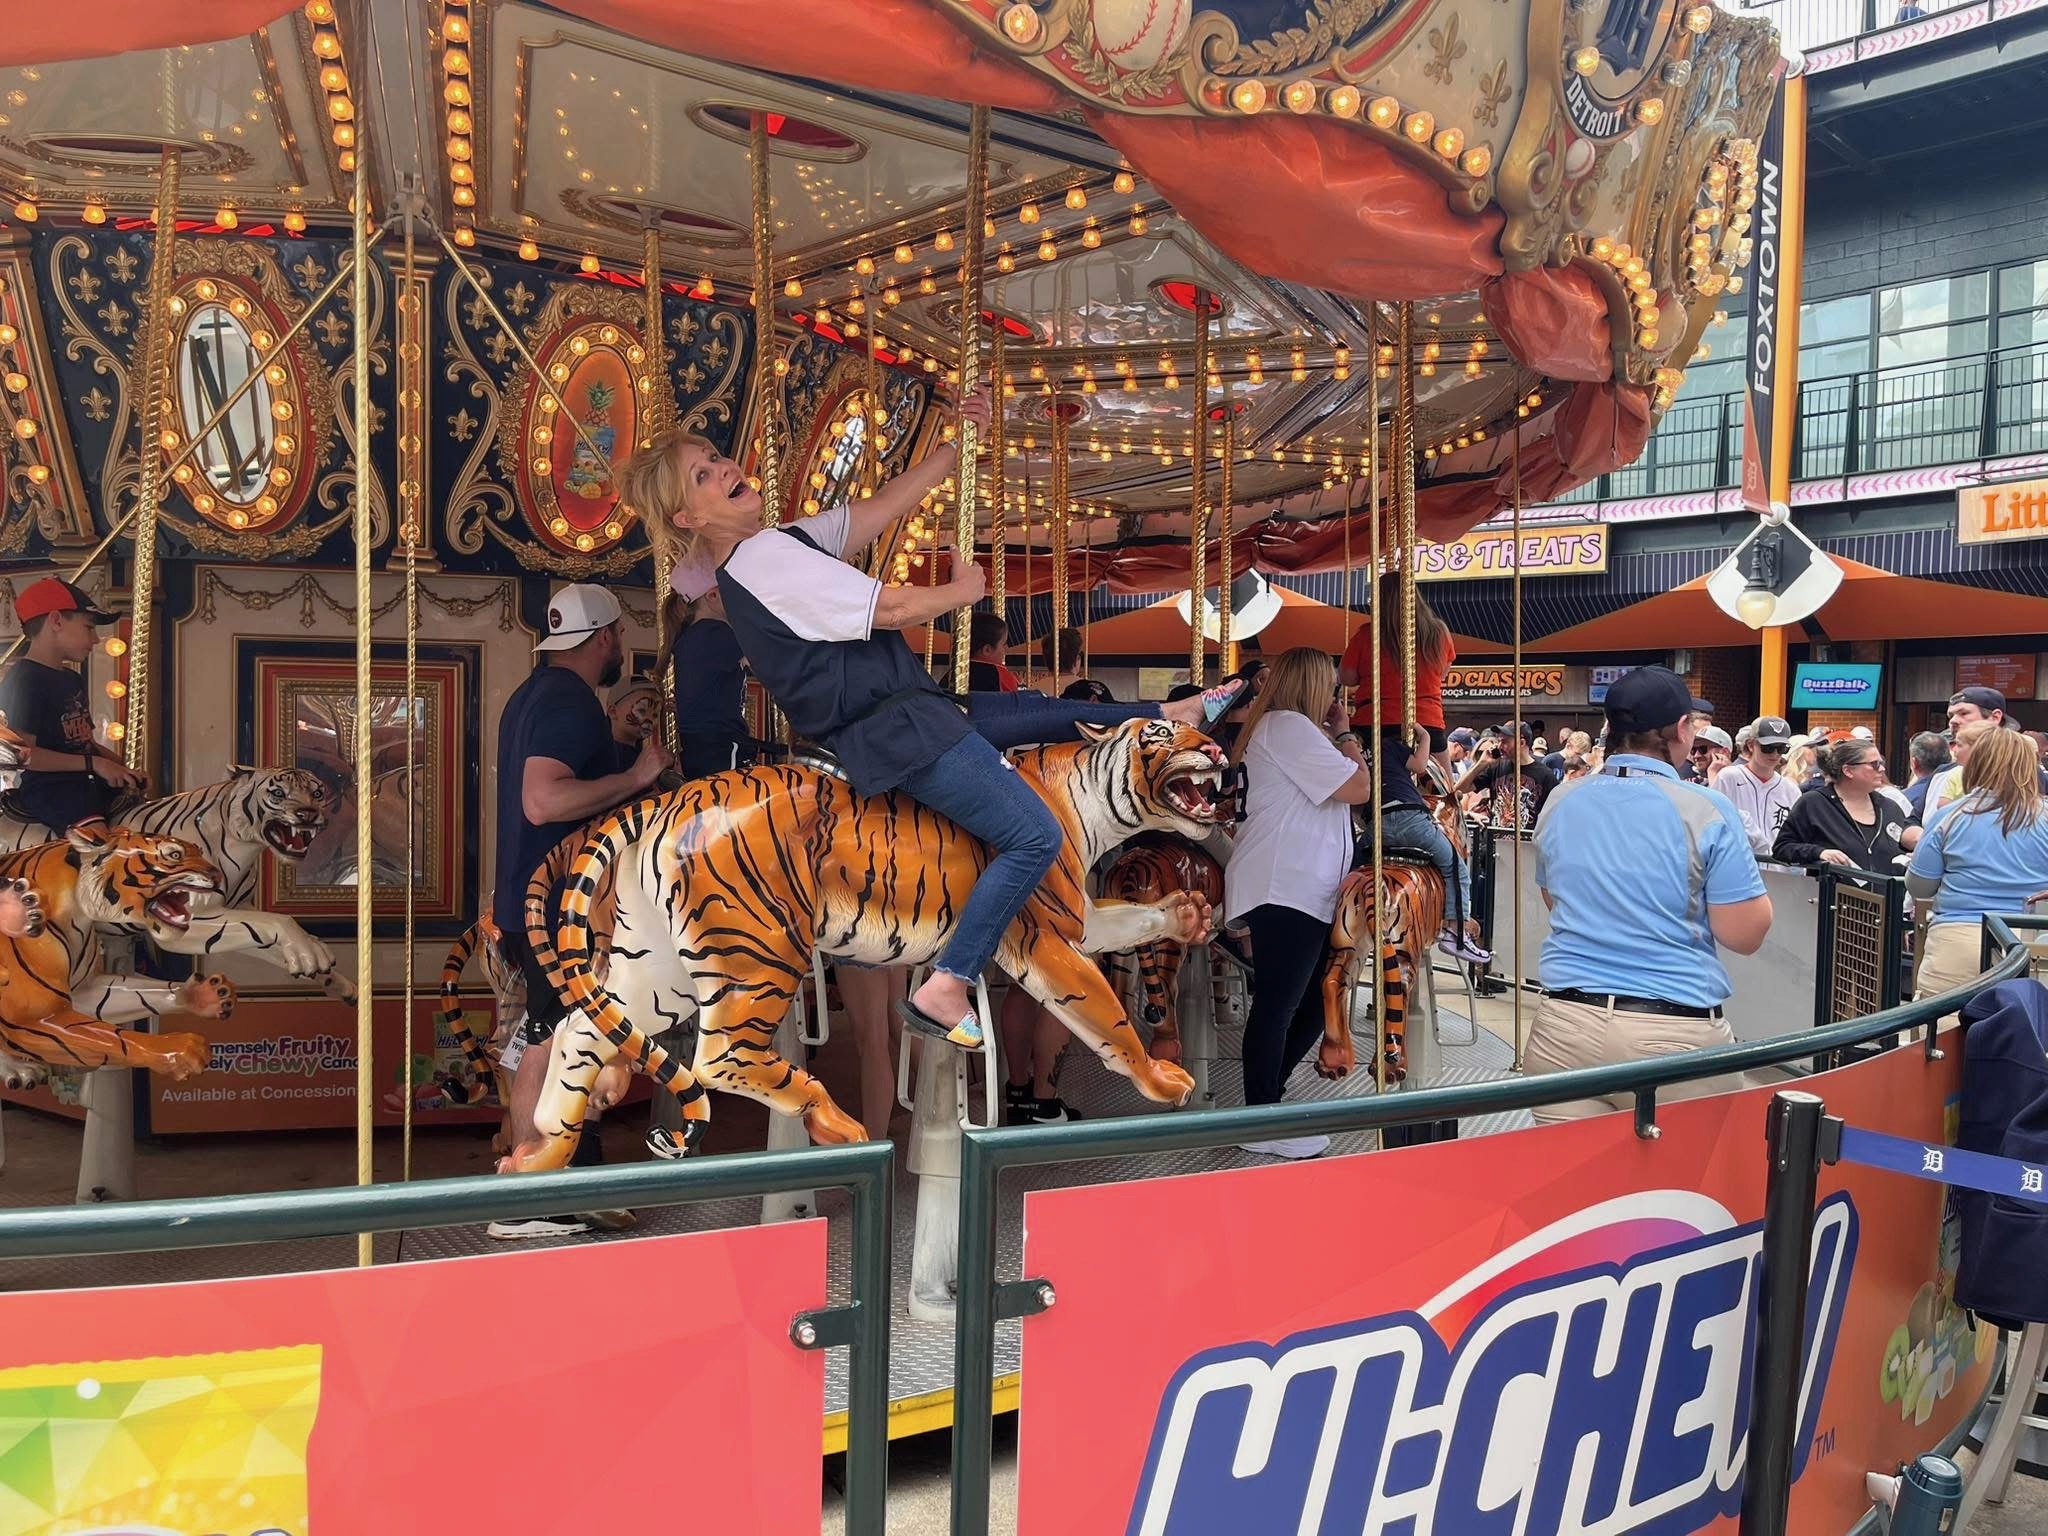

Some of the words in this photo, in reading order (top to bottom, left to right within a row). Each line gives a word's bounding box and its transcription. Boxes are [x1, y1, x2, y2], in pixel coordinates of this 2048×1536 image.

[1566, 75, 1624, 137] DETROIT
[1754, 158, 1779, 396] FOXTOWN
[1982, 491, 2048, 533] Litt
[1449, 542, 1473, 571] &
[1474, 533, 1601, 569] TREATS
[1442, 688, 1464, 698] DOGS
[1469, 688, 1511, 697] ELEPHANT
[1511, 688, 1532, 697] ERS
[278, 1035, 351, 1057] Fruity
[204, 1053, 234, 1073] ely
[234, 1053, 320, 1077] Chewy
[161, 1087, 237, 1103] Available
[241, 1088, 257, 1100] at
[1814, 1427, 1836, 1461] TM
